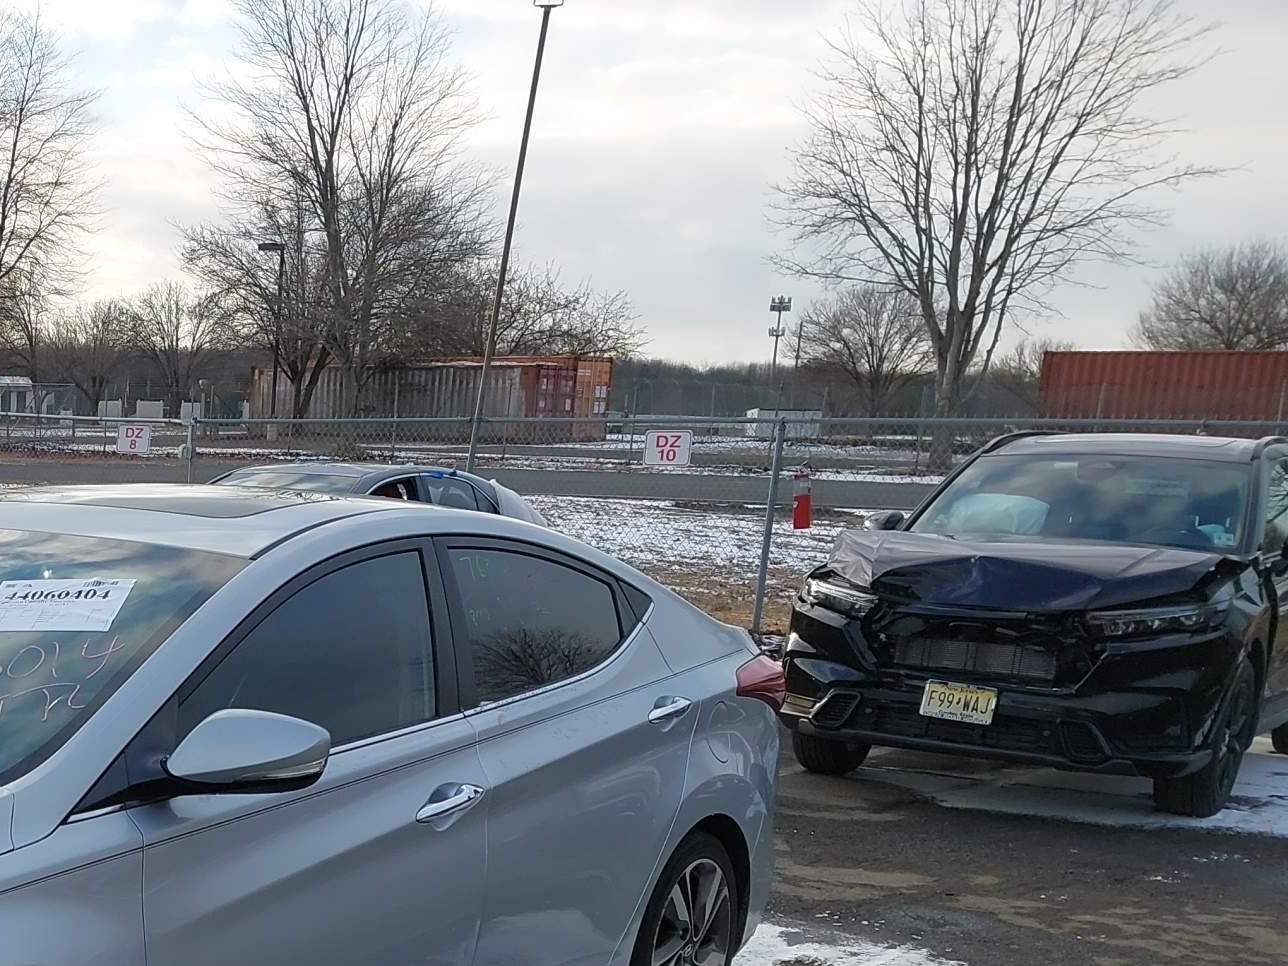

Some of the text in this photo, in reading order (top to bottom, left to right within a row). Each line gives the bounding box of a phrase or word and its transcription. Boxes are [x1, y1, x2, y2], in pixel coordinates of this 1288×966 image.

[125, 428, 144, 438] DZ
[129, 439, 137, 449] 8
[655, 435, 682, 448] DZ
[658, 449, 676, 461] 10
[4, 588, 112, 601] 44060404
